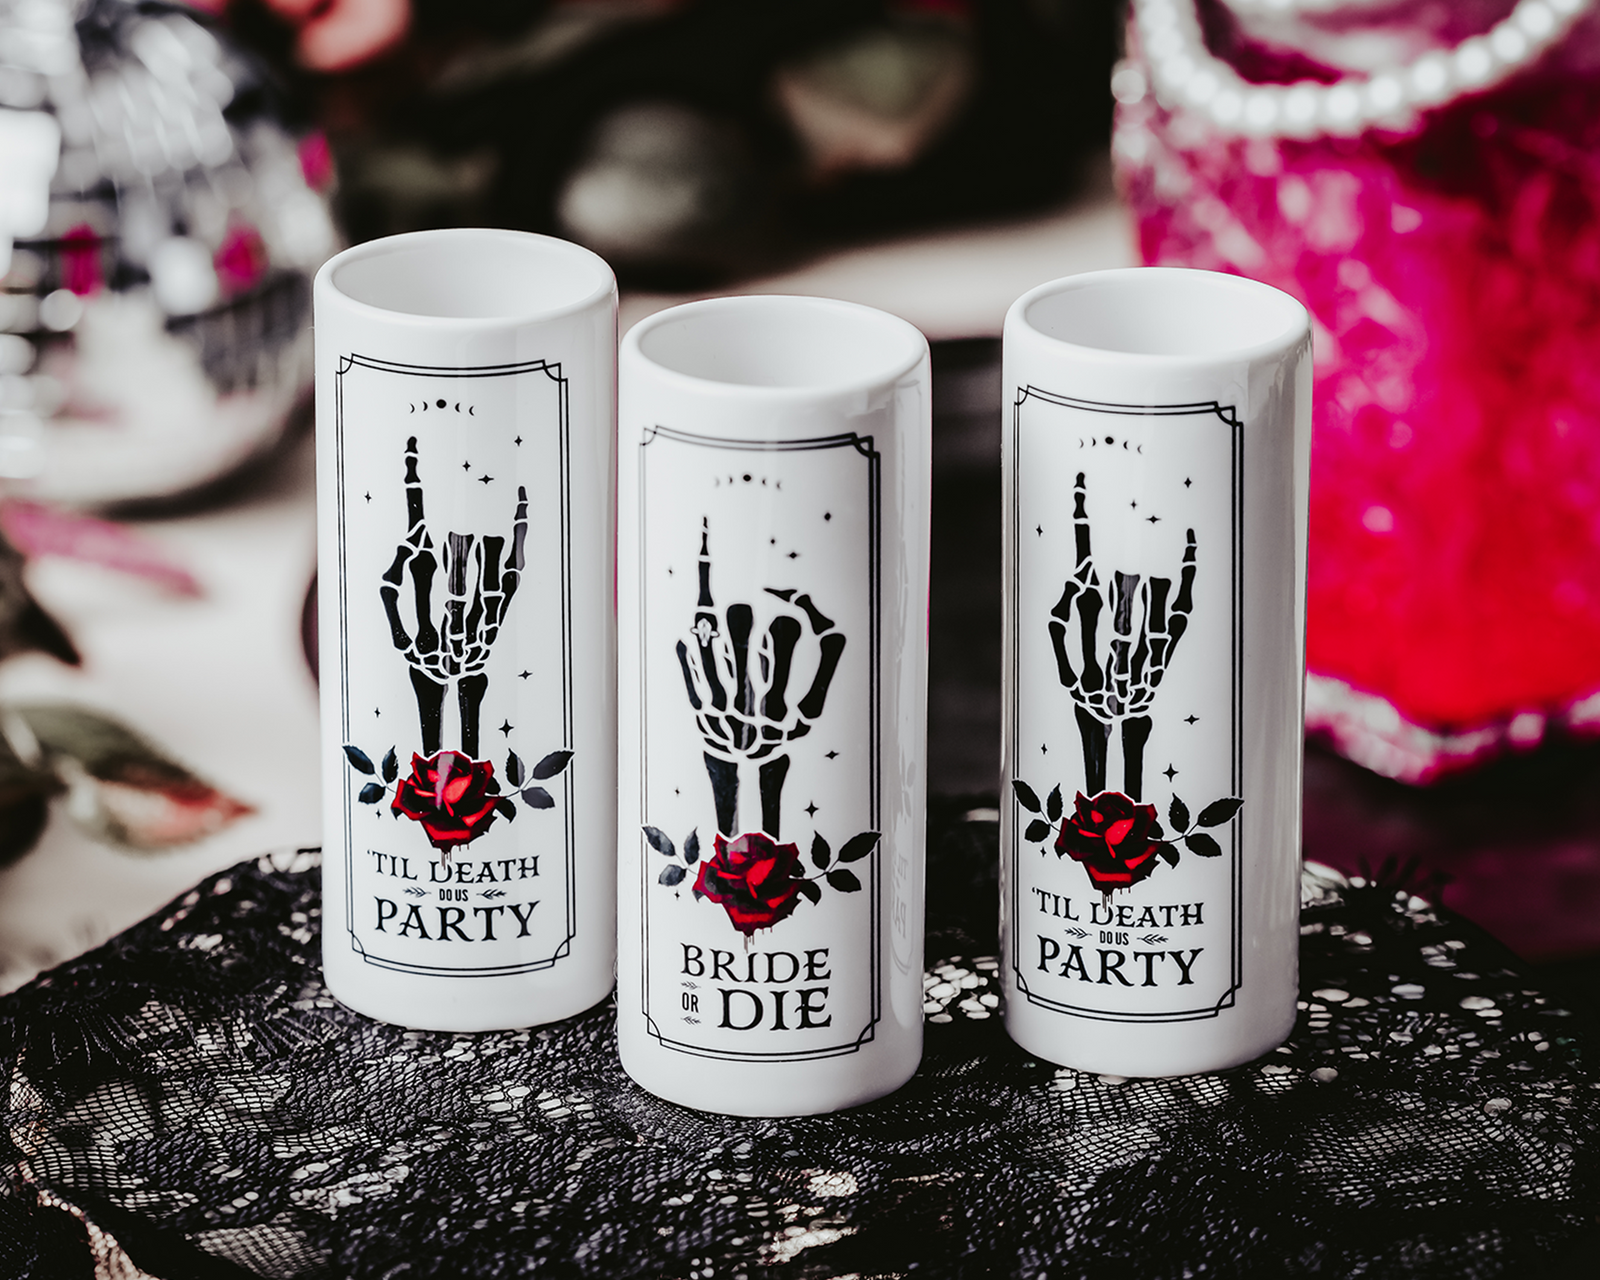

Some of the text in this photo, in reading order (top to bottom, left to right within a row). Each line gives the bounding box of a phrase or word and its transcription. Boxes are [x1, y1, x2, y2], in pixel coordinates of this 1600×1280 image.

[428, 854, 541, 884] DEATH
[439, 888, 469, 902] DO US
[373, 895, 541, 942] PARTY
[1089, 902, 1205, 928] DEATH
[1099, 930, 1130, 946] DO US
[680, 942, 832, 983] BRIDE
[1037, 934, 1205, 988] PARTY
[681, 986, 832, 1031] OR DIE
